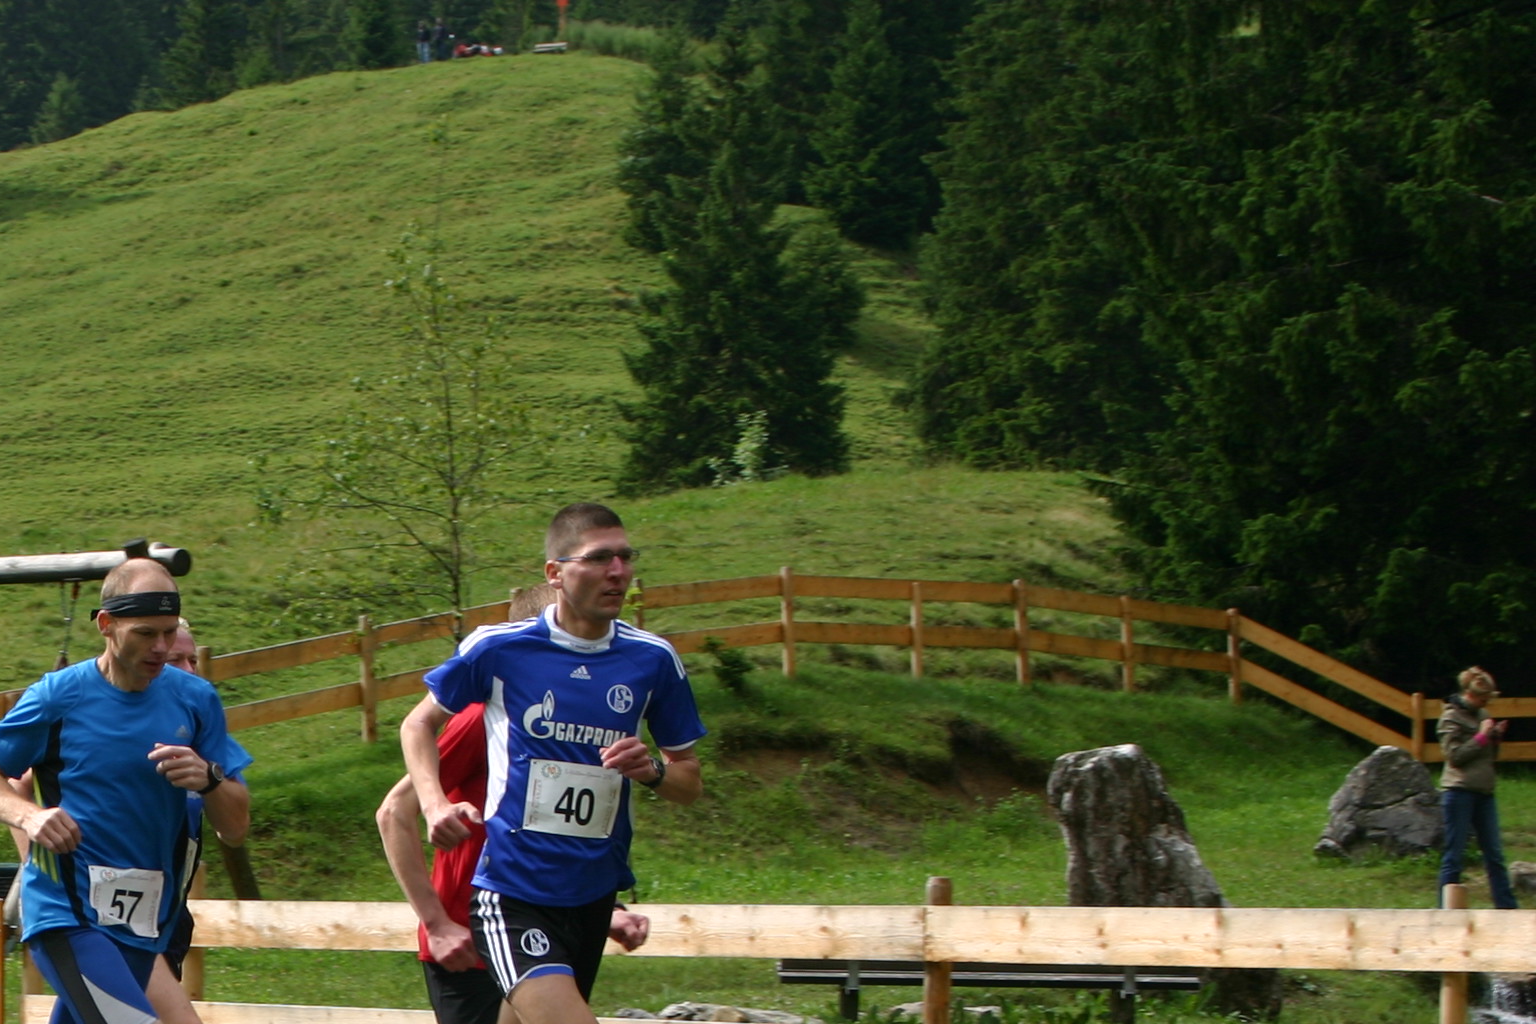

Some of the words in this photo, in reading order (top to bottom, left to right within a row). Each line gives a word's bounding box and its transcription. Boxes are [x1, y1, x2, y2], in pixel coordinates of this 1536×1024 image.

[555, 722, 627, 747] GAZPROM
[554, 787, 595, 826] 40
[109, 889, 144, 923] 57
